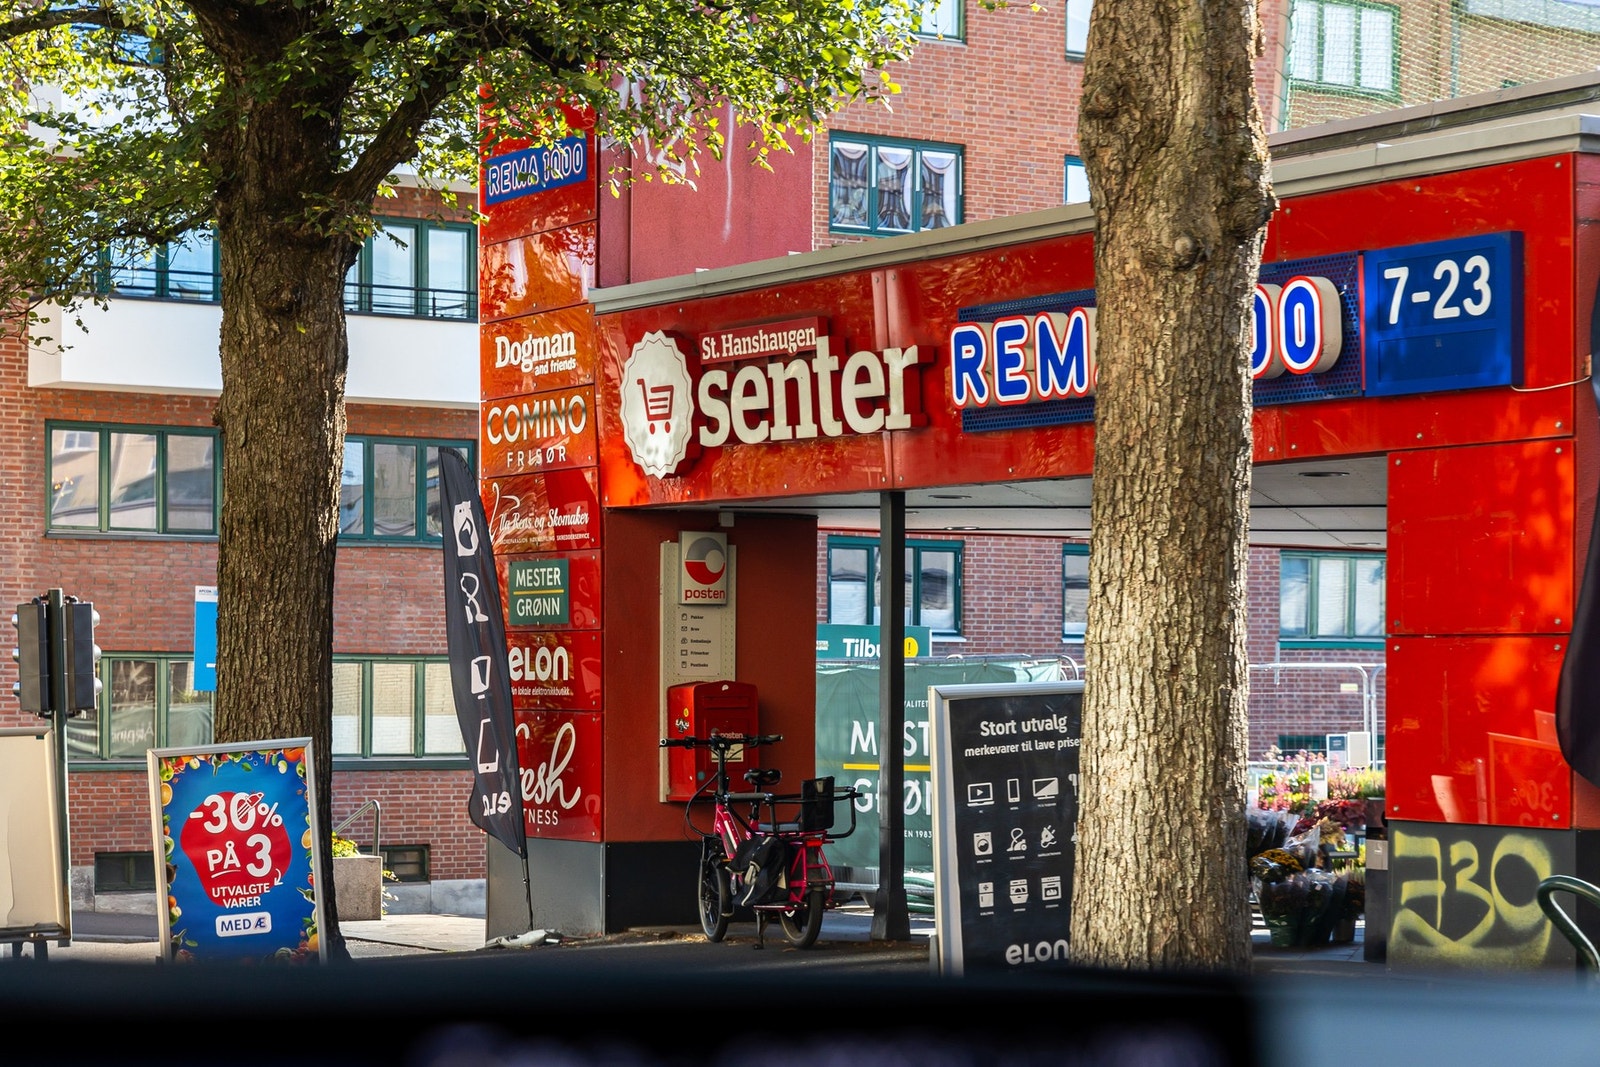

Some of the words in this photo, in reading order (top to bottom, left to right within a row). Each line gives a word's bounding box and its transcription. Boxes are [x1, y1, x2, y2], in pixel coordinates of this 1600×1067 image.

[489, 155, 539, 196] REMA
[542, 143, 583, 182] 1000
[1383, 255, 1492, 325] 7-23
[495, 331, 576, 373] Dogman
[702, 337, 720, 360] St.
[721, 327, 816, 357] Hanshaugen
[951, 306, 1098, 407] REM
[534, 362, 549, 376] and
[550, 357, 576, 373] friends
[698, 335, 918, 447] senter
[486, 395, 587, 445] COMINO
[534, 516, 546, 534] og
[547, 506, 590, 528] Skomaker
[515, 567, 561, 588] MESTER
[516, 597, 560, 616] GRØNN
[684, 588, 725, 601] posten
[980, 720, 1017, 737] Stort
[1021, 714, 1068, 734] utvalg
[965, 743, 1019, 757] merkevarer
[1021, 740, 1033, 752] til
[1035, 740, 1055, 751] lave
[189, 791, 283, 834] -30%
[207, 840, 241, 872] PÅ
[246, 833, 272, 878] 3
[211, 882, 271, 898] UTVALGTE
[222, 896, 261, 909] VARER
[220, 918, 252, 932] MED
[254, 917, 267, 929] Æ
